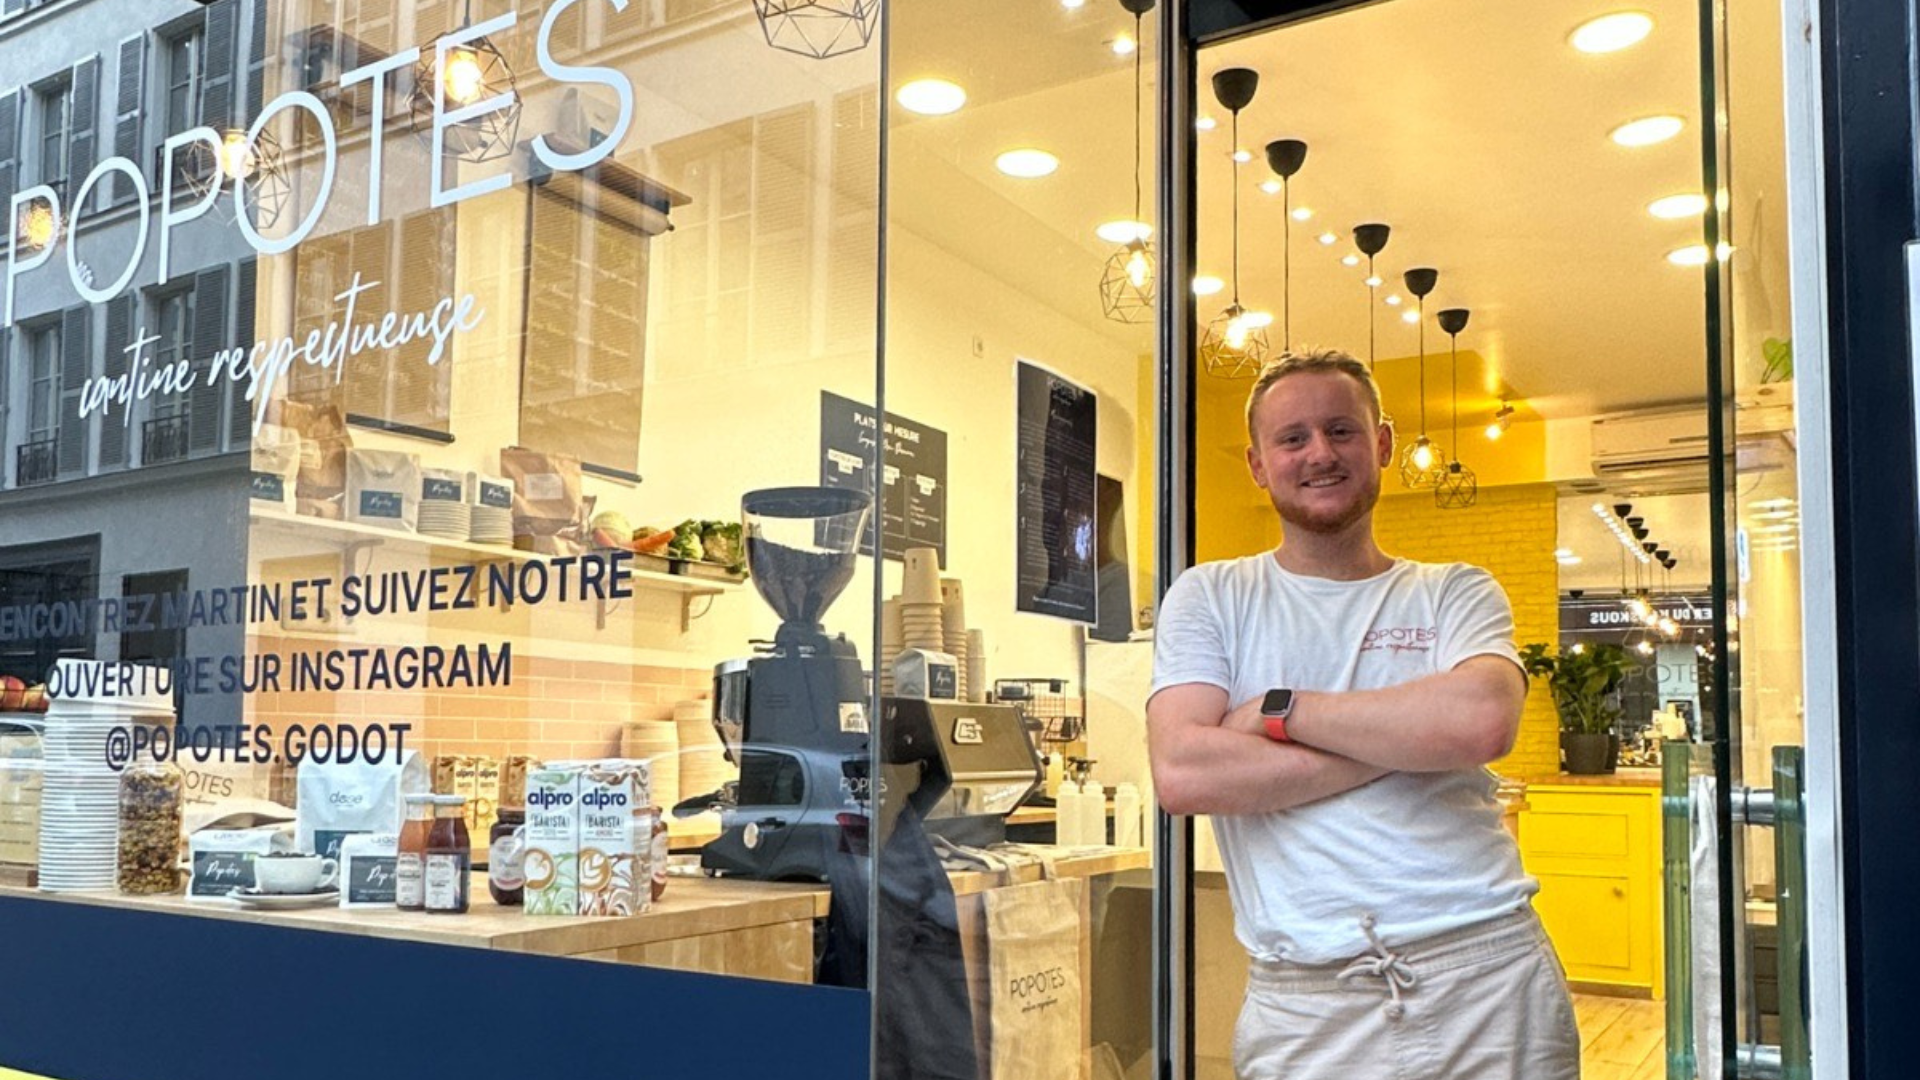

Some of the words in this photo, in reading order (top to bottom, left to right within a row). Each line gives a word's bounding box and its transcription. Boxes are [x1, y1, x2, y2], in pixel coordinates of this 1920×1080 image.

[4, 0, 634, 327] POPOTES
[79, 327, 197, 427] cantine
[206, 271, 486, 437] respectueuse
[0, 593, 155, 641] ENCONTREZ
[162, 583, 280, 630] MARTIN
[290, 579, 332, 620] ET
[341, 564, 477, 618] SUIVEZ
[488, 551, 634, 608] NOTRE
[1363, 626, 1437, 643] OPOTES
[46, 656, 211, 699] OUVERTURE
[218, 652, 281, 695] SUR
[291, 642, 512, 692] INSTAGRAM
[105, 723, 412, 772] @POPOTES.GODOT
[527, 787, 573, 810] alpro
[581, 787, 627, 810] alpro
[1010, 967, 1066, 1000] POPOTES
